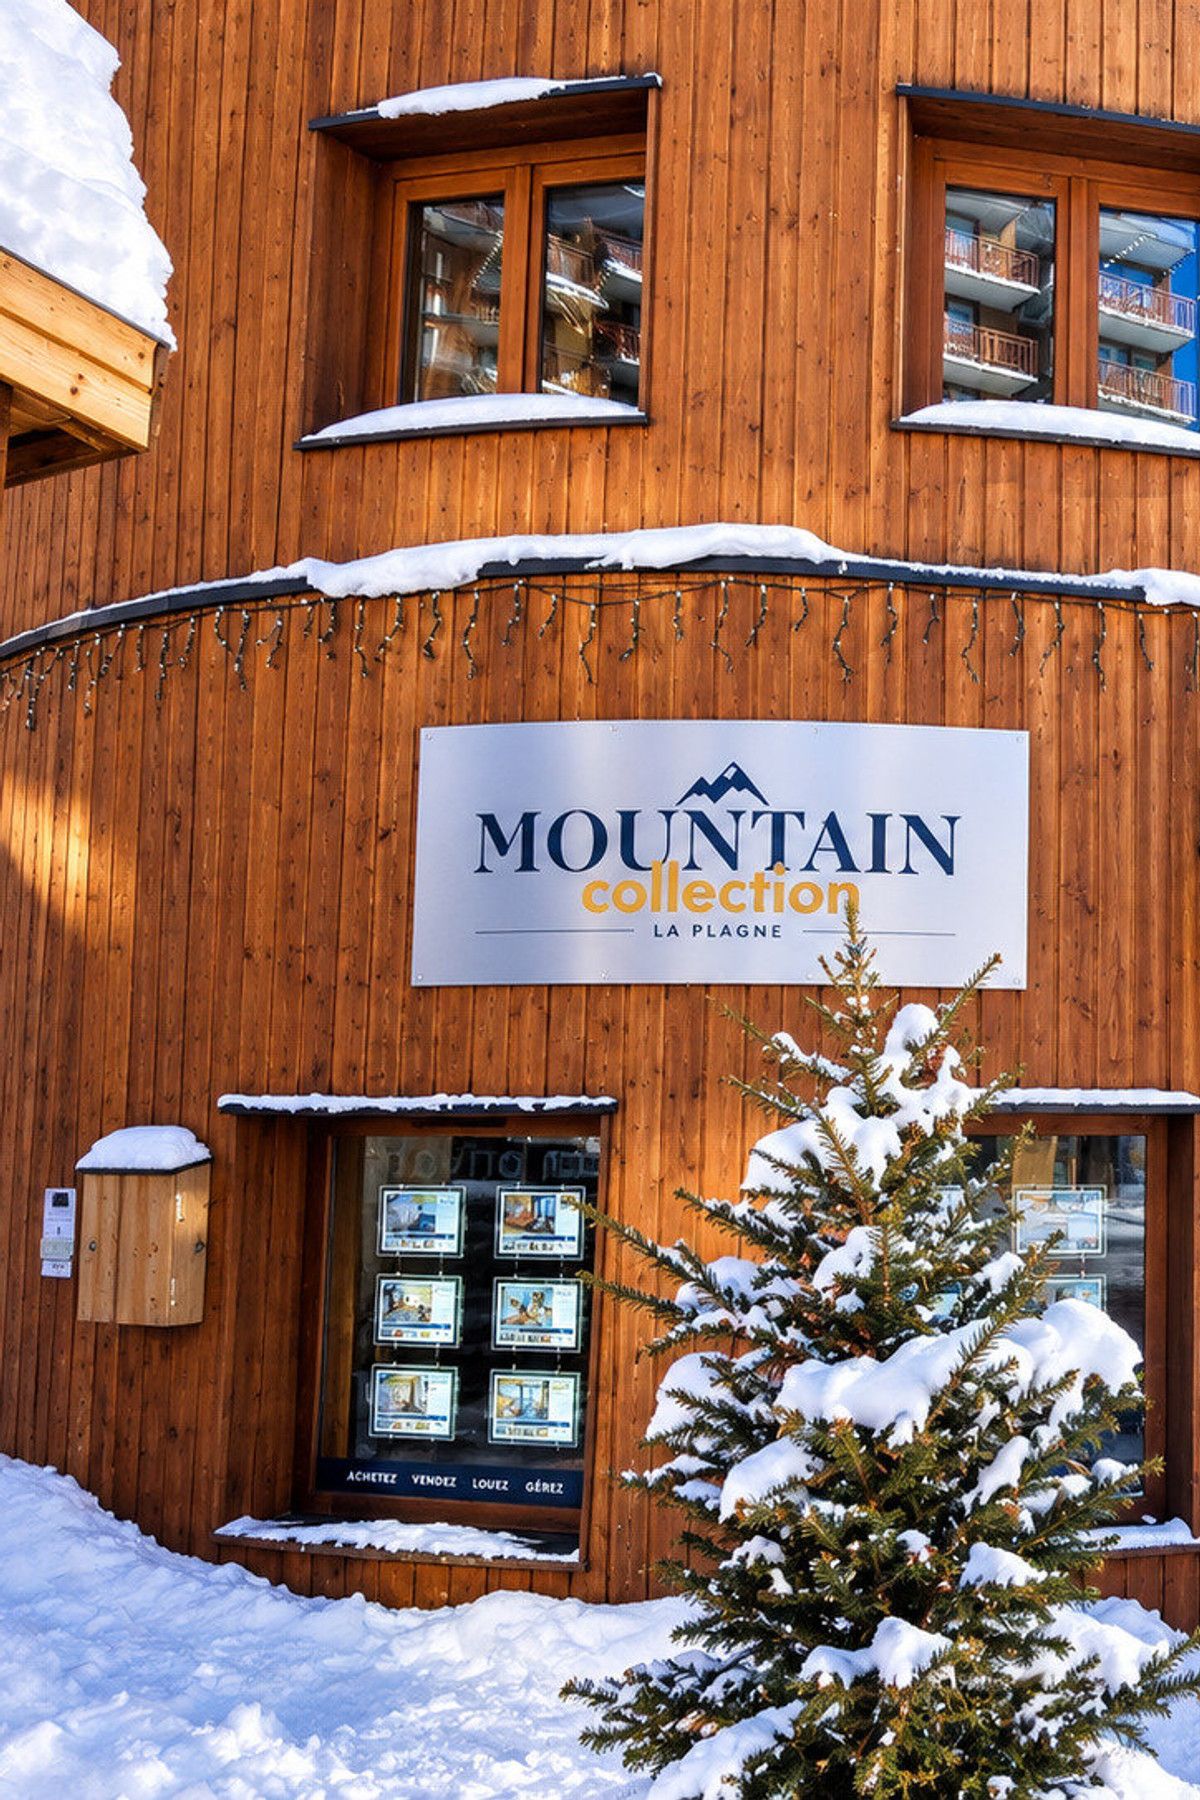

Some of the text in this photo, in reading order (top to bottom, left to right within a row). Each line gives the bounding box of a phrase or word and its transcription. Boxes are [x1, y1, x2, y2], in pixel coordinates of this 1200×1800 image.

[473, 808, 961, 876] MOUNTAIN
[582, 860, 860, 914] collection
[654, 924, 782, 938] LA PLAGNE
[346, 1471, 564, 1494] ACHETEZ VENDEZ LOUEZ GÉREZ
